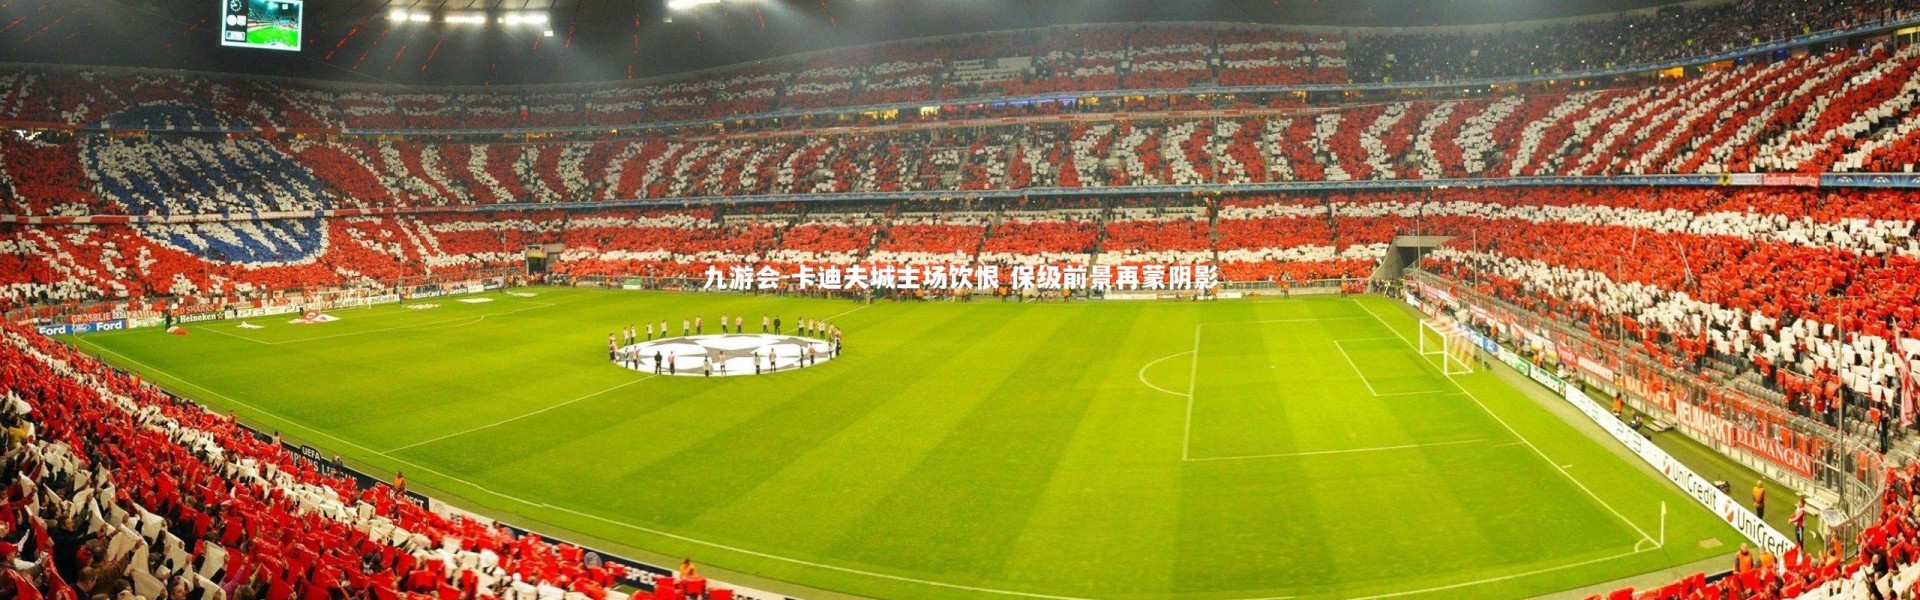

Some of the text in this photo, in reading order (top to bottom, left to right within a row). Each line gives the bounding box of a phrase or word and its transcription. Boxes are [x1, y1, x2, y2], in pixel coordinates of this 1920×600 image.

[39, 325, 66, 336] Ford
[96, 320, 123, 331] Ford
[180, 313, 217, 323] Heineken
[1677, 400, 1733, 446] NEUMARKT
[301, 446, 321, 461] UEFA
[1737, 427, 1811, 473] ELLWANGEN
[1672, 463, 1718, 511] UniCredit
[1737, 508, 1793, 556] UniCredi
